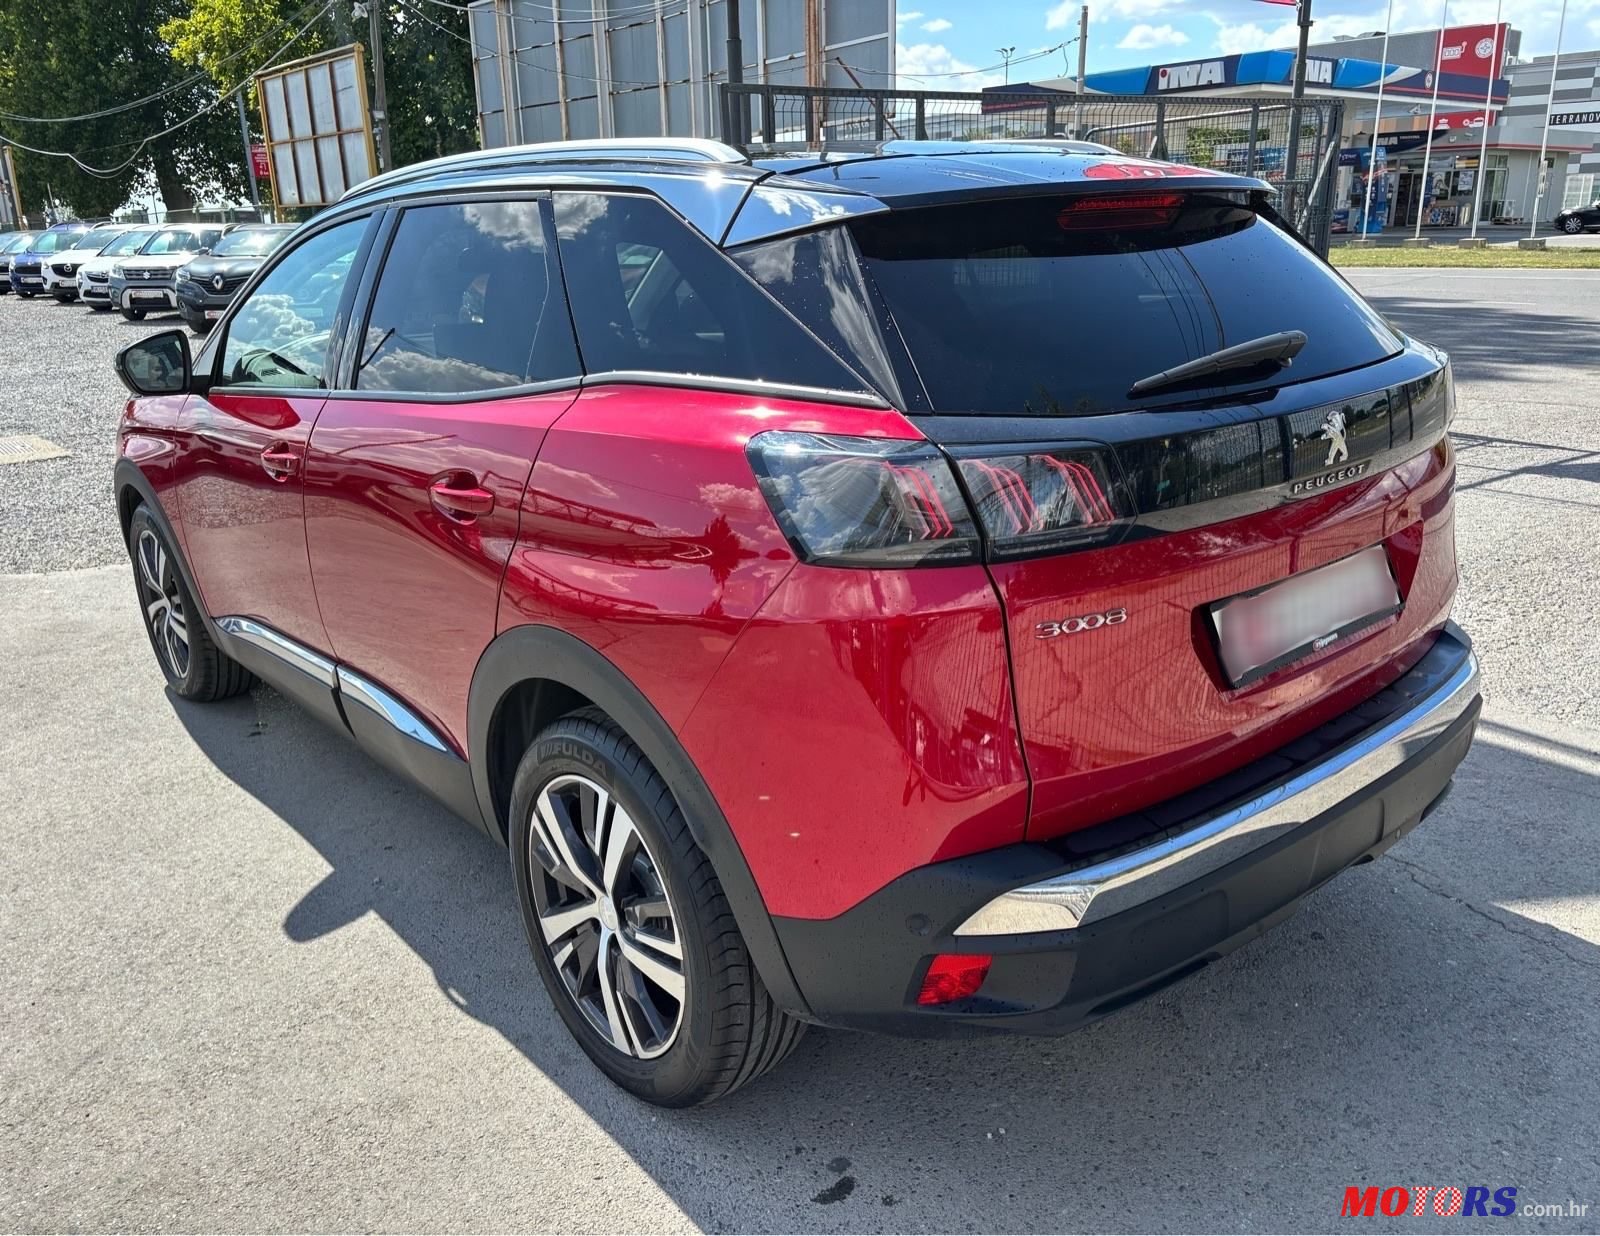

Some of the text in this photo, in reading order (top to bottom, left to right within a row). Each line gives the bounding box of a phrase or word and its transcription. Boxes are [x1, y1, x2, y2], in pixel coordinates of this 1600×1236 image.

[1551, 113, 1600, 124] TERRANOV
[1294, 464, 1364, 493] PEUGEOT
[1035, 607, 1127, 638] 3008
[551, 742, 607, 778] FULDA
